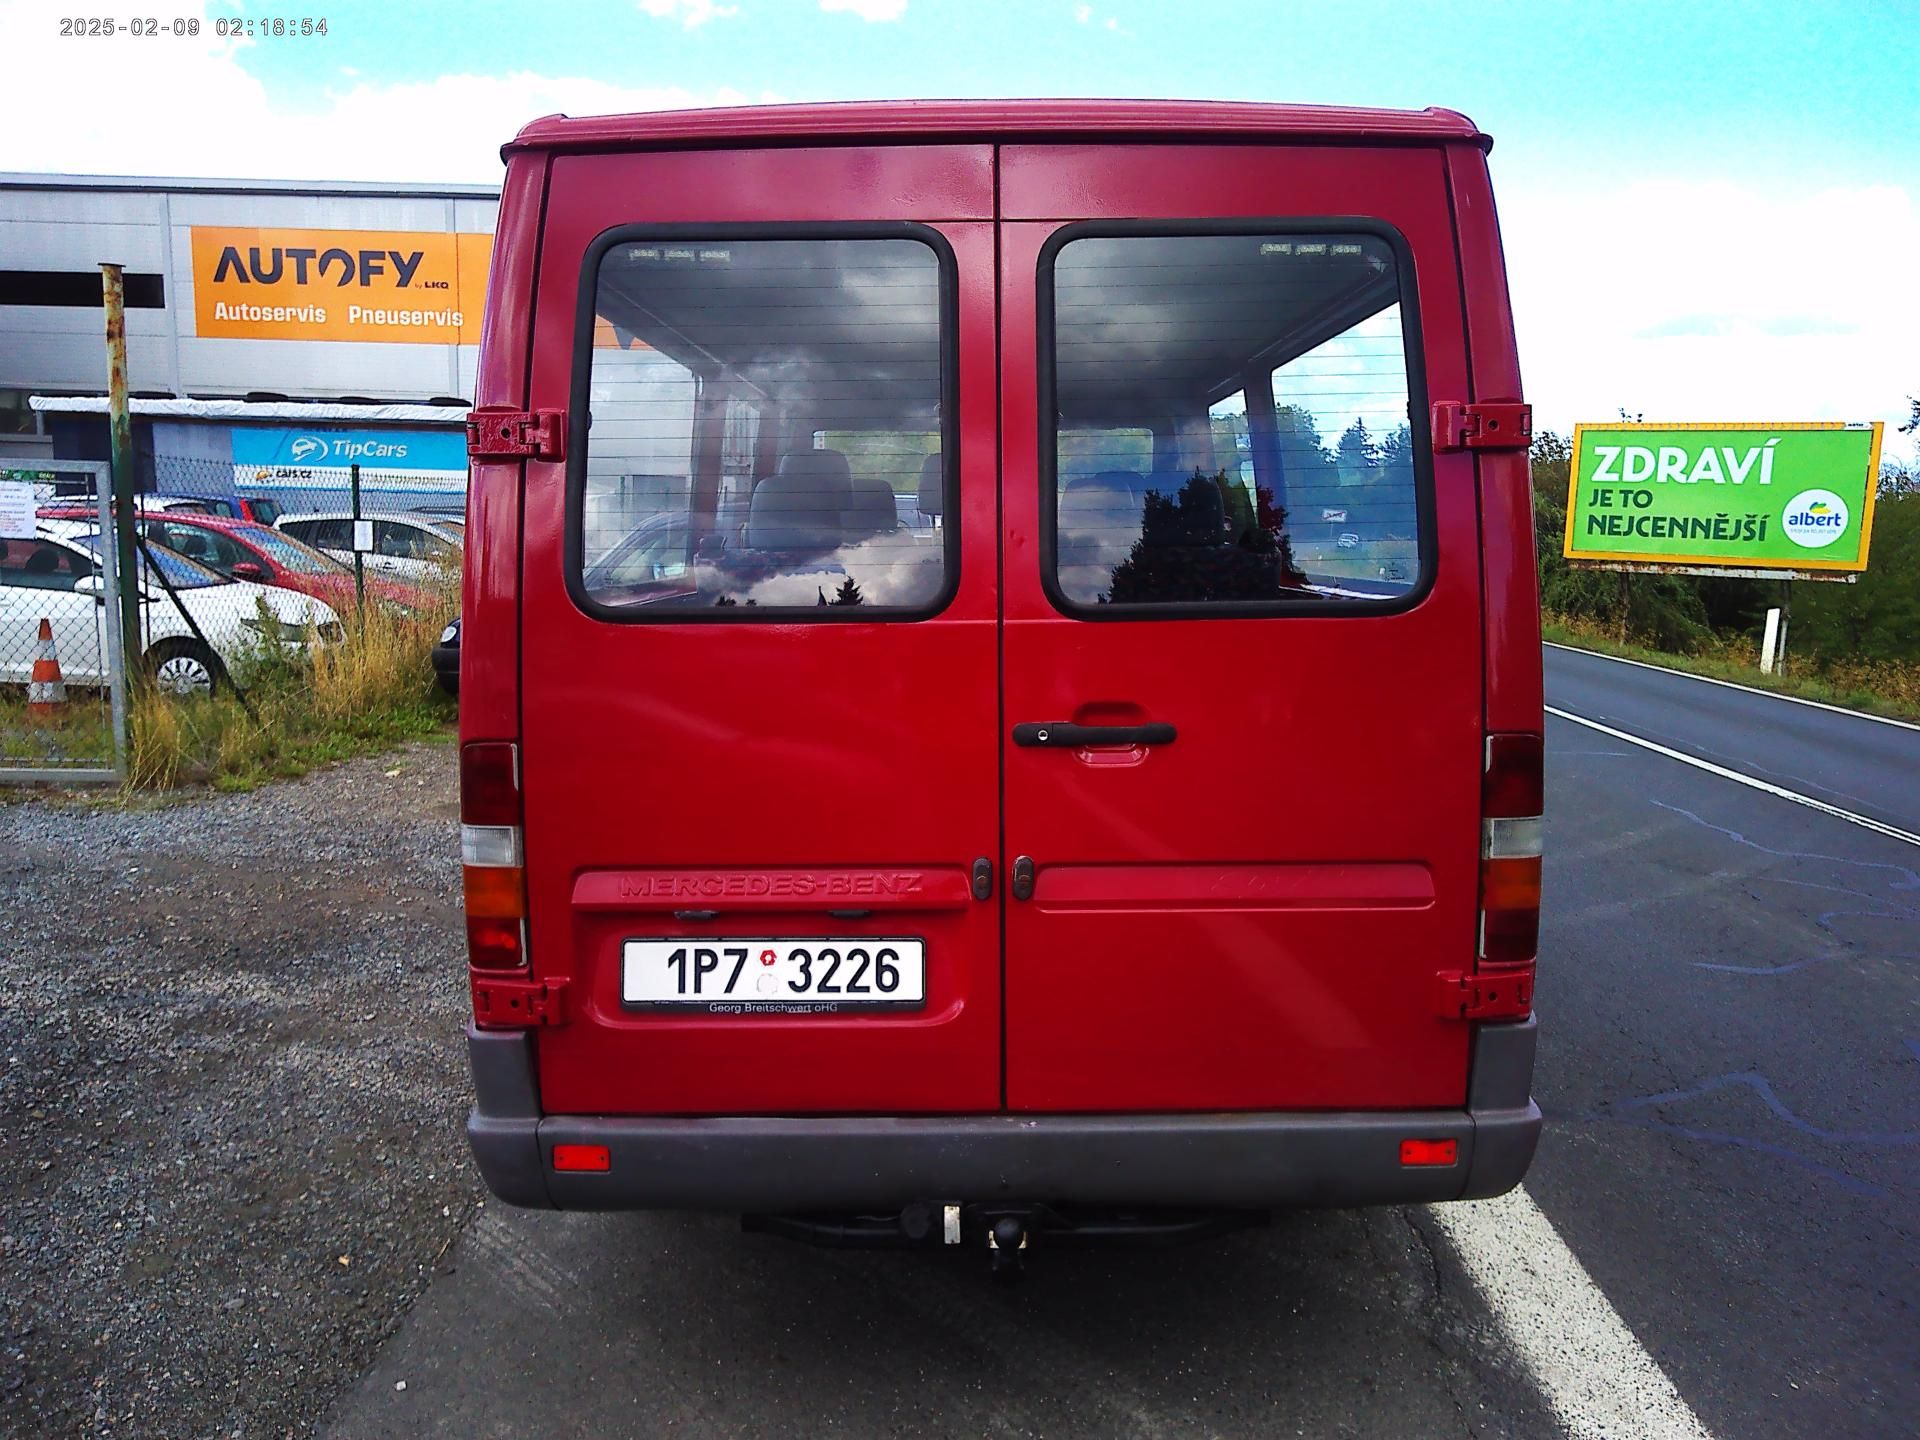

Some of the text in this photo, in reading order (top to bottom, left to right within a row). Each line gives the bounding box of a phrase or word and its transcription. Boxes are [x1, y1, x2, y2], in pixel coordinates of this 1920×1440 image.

[213, 246, 424, 288] AUTOFY
[424, 281, 449, 289] LKQ
[214, 302, 464, 327] Autoservis Pneuservis
[332, 440, 408, 459] TipCars
[1591, 438, 1782, 485] ZDRAVÍ
[1588, 489, 1654, 508] JE TO
[1587, 513, 1772, 542] NEJCENNĚJŠÍ
[1788, 512, 1842, 527] albert
[621, 872, 923, 897] MERCEDES-BENZ
[667, 948, 900, 994] 1P7 3226
[709, 1002, 838, 1014] Georg Breitschwert oHG
